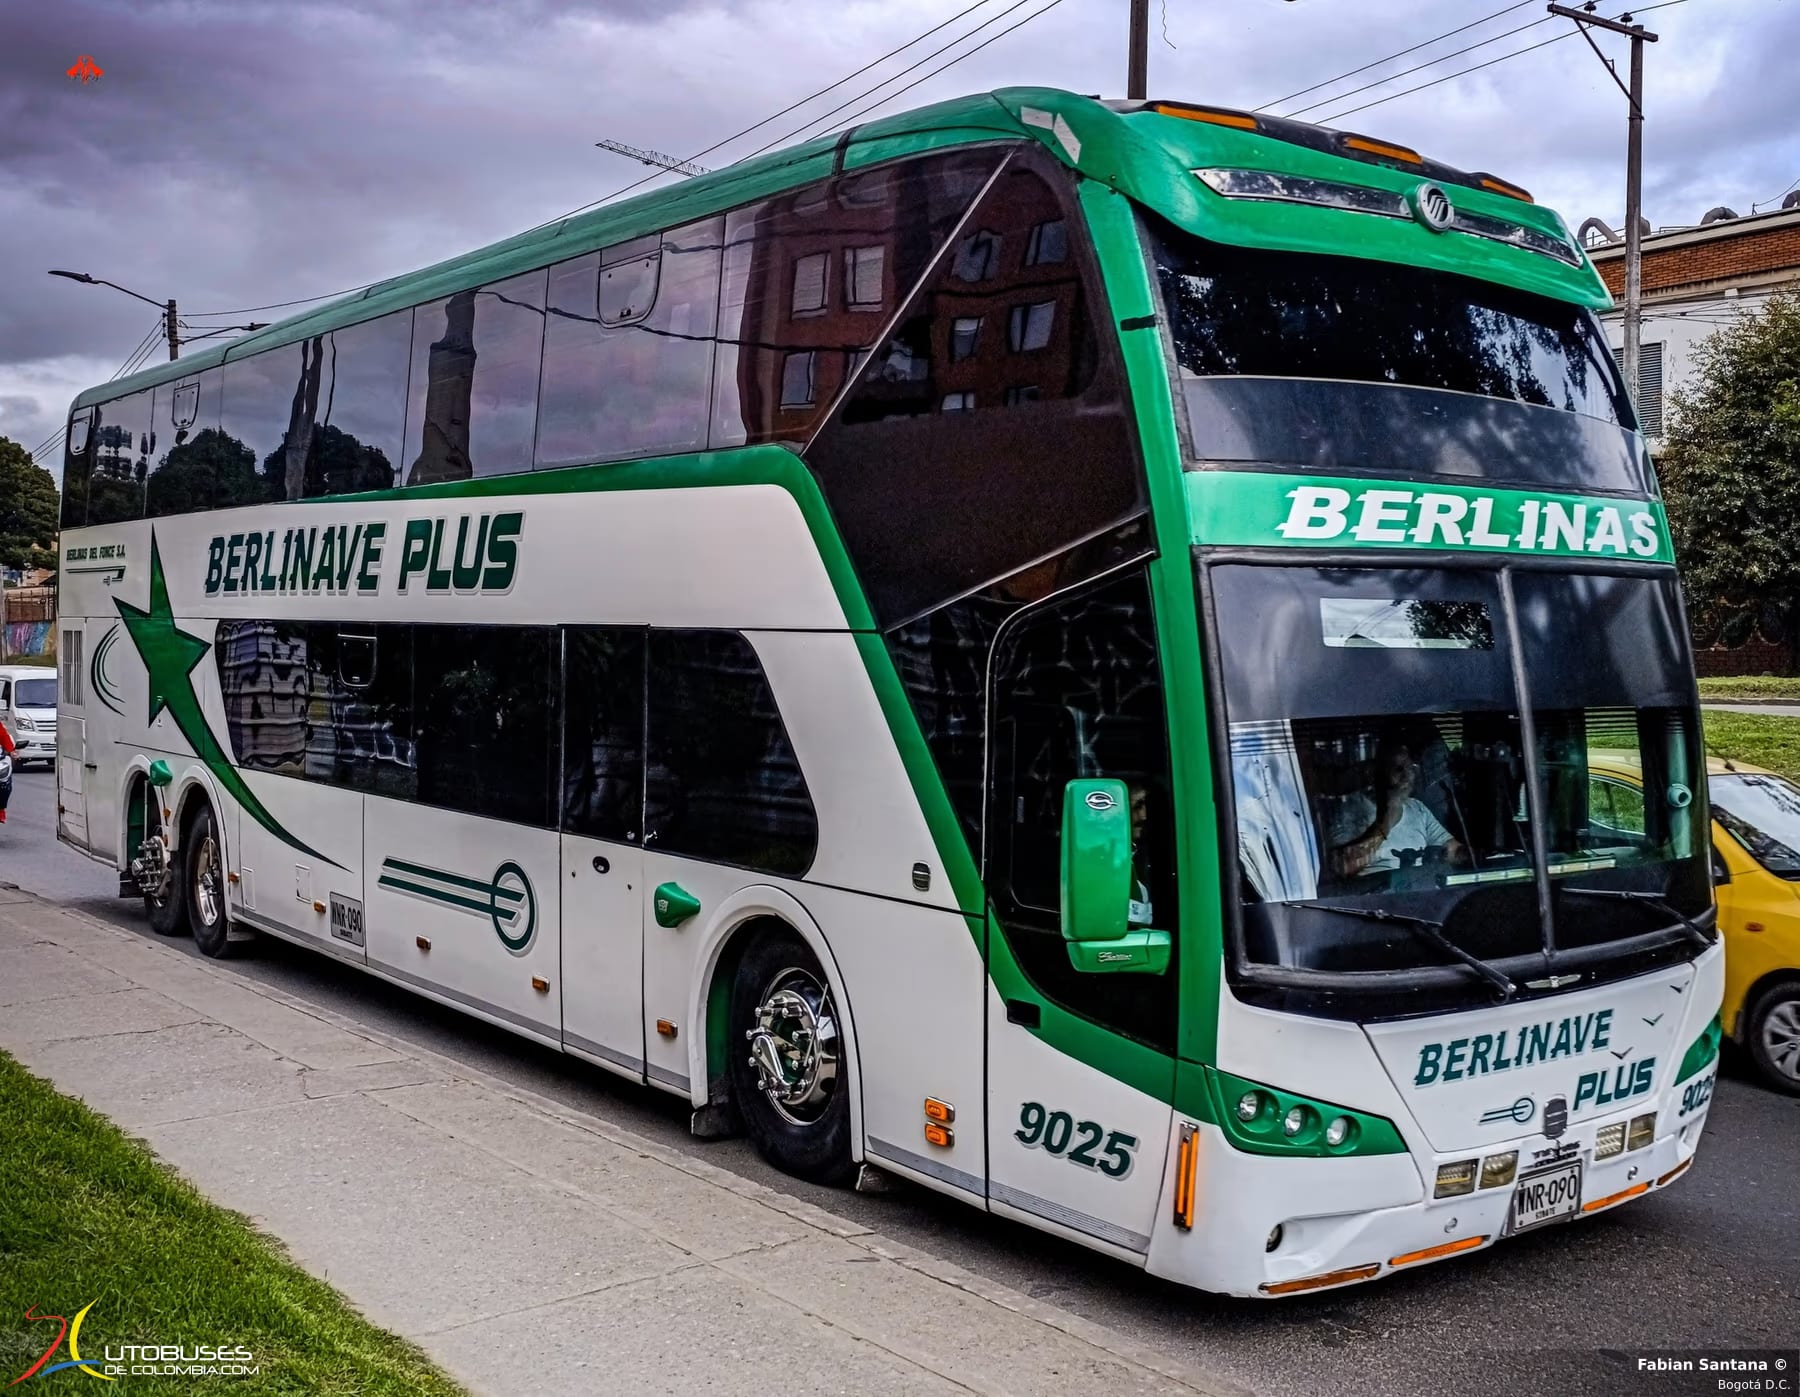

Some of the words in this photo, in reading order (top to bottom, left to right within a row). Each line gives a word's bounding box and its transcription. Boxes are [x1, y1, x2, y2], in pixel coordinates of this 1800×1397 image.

[205, 523, 387, 593] BERLINAVE
[397, 512, 523, 590] PLUS
[1276, 486, 1659, 556] BERLINAS
[1414, 1008, 1613, 1087] BERLINAVE
[1572, 1056, 1656, 1111] PLUS
[1014, 1102, 1137, 1177] 9025
